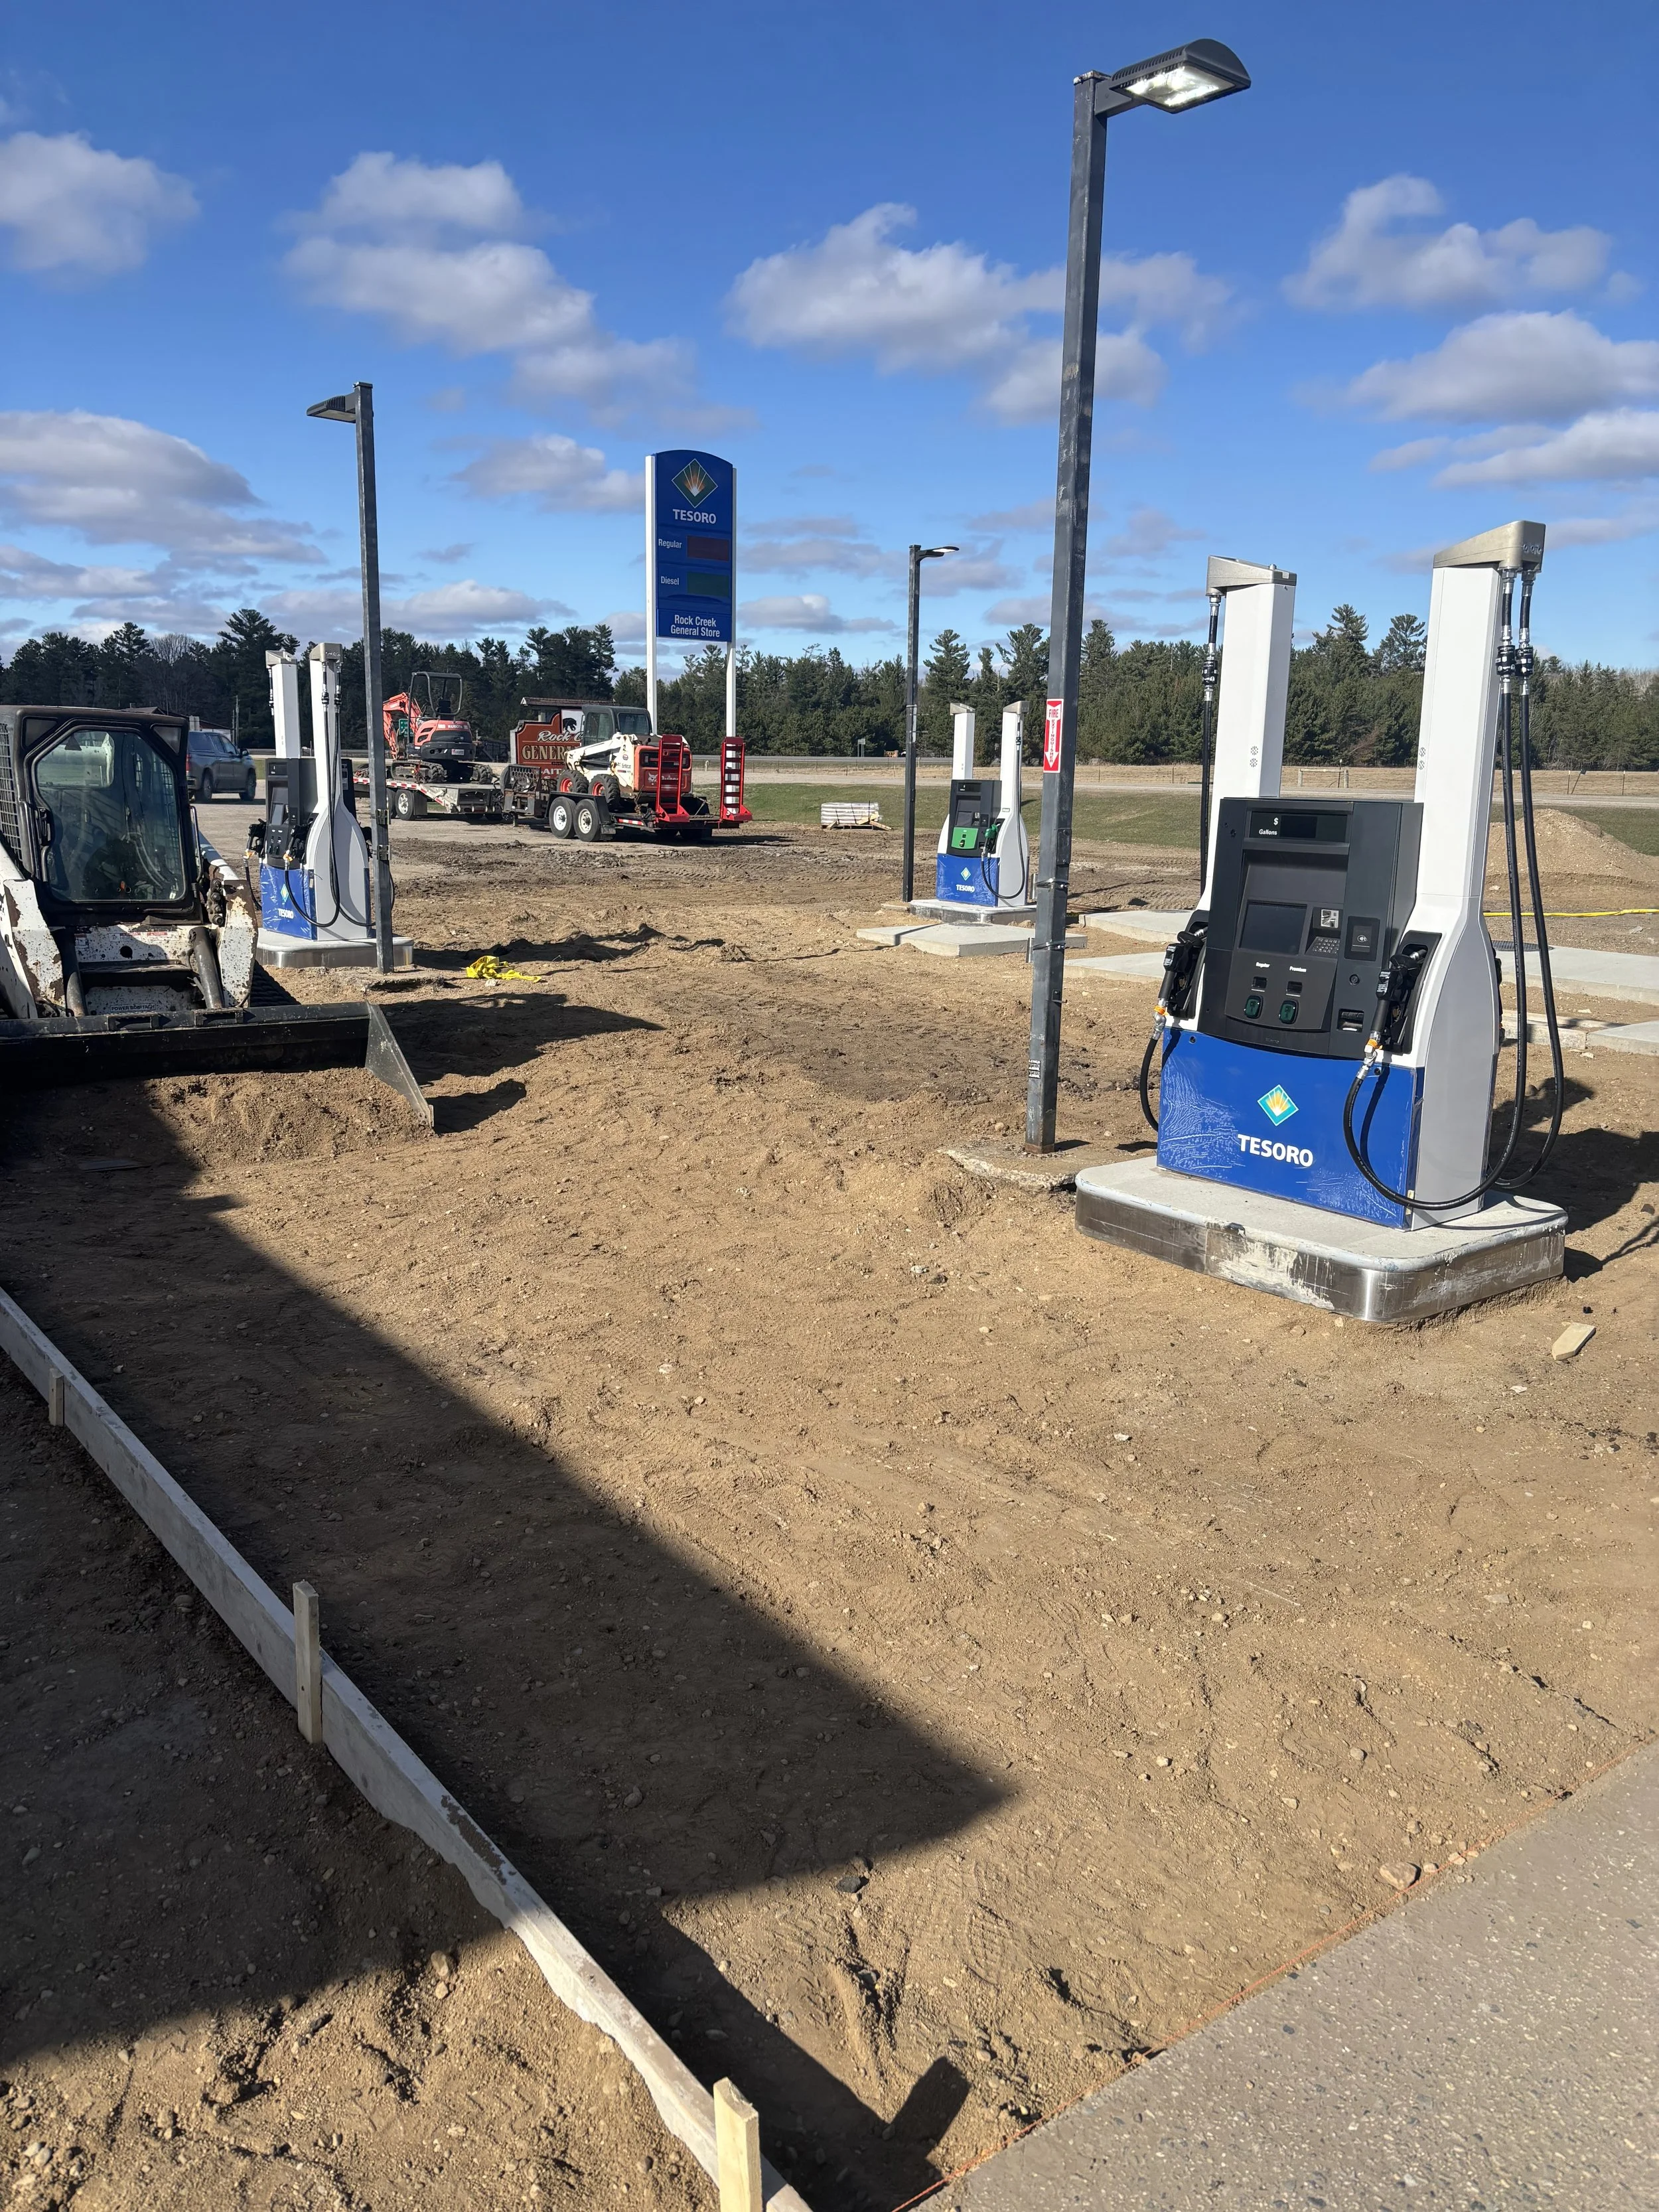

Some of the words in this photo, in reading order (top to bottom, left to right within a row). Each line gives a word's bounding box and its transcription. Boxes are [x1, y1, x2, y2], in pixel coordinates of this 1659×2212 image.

[672, 508, 717, 524] TESORO
[658, 538, 682, 549] Regular
[660, 576, 680, 585] Diesel
[674, 615, 693, 626] Rock
[695, 616, 717, 627] Creek
[670, 625, 699, 636] General
[700, 627, 720, 638] Store
[1048, 709, 1059, 718] FIRE
[538, 730, 571, 742] Rock
[522, 745, 581, 760] GENER
[1273, 817, 1279, 826] $
[956, 884, 975, 893] TESORO
[277, 908, 294, 919] TESORO
[1237, 1134, 1313, 1167] TESORO
